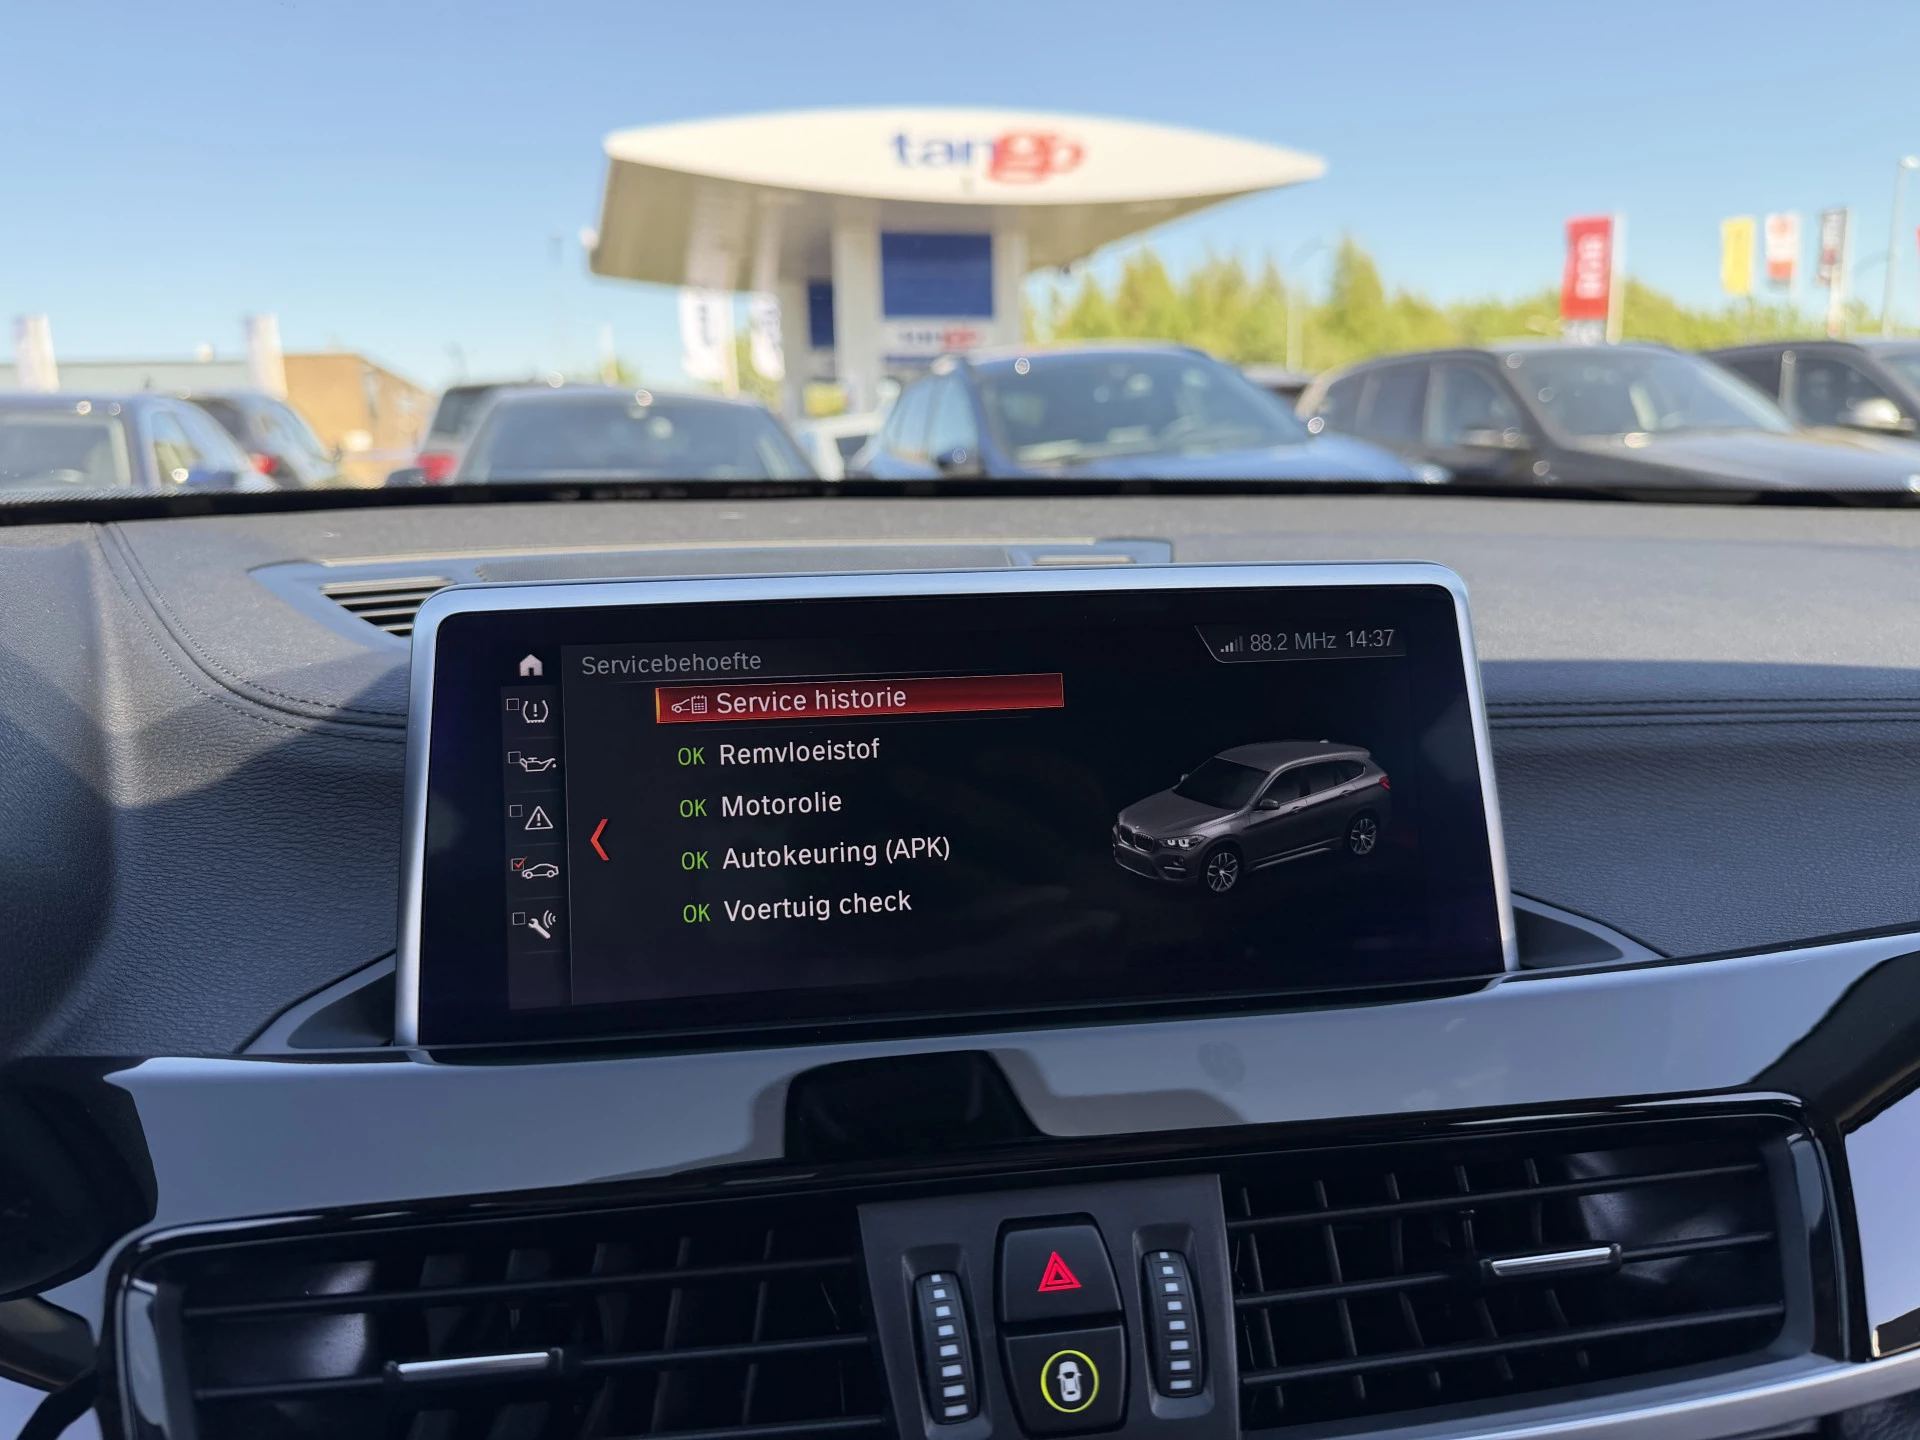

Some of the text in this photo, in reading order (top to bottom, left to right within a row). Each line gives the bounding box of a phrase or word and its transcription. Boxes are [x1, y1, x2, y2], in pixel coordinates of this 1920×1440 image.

[1250, 628, 1395, 652] 88.2 MHz 14:37
[582, 651, 762, 675] Servicebehoefte
[716, 686, 907, 714] Service historie
[677, 737, 880, 766] OK Remvloeistof
[679, 791, 842, 818] OK Motorolie
[681, 836, 950, 871] OK Autokeuring (APK)
[683, 889, 912, 924] OK Voertuig check
